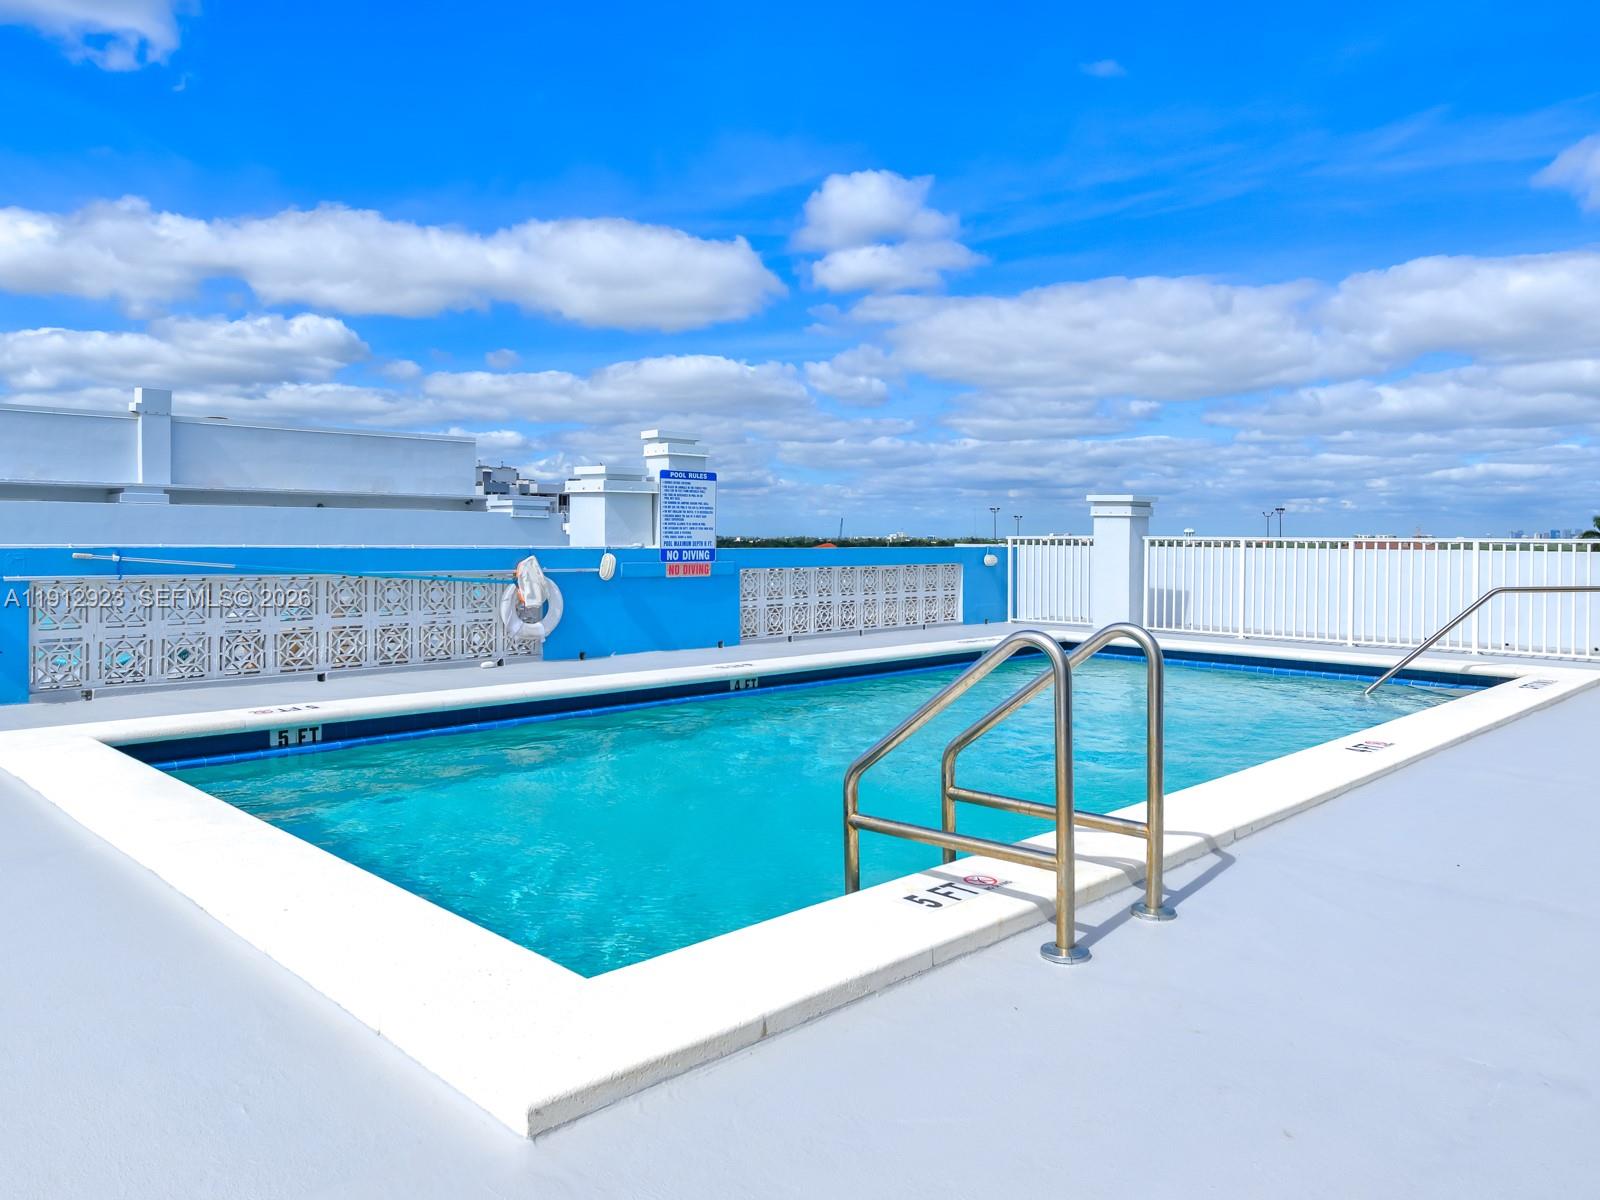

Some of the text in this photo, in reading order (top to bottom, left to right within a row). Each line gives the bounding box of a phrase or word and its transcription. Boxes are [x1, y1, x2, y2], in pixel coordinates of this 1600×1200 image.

[670, 471, 708, 480] POOL RULES
[666, 550, 710, 561] NO DIVING
[668, 563, 710, 576] NO DIVING
[278, 726, 320, 747] 5 FT
[903, 894, 944, 909] 5
[926, 882, 980, 902] FT
